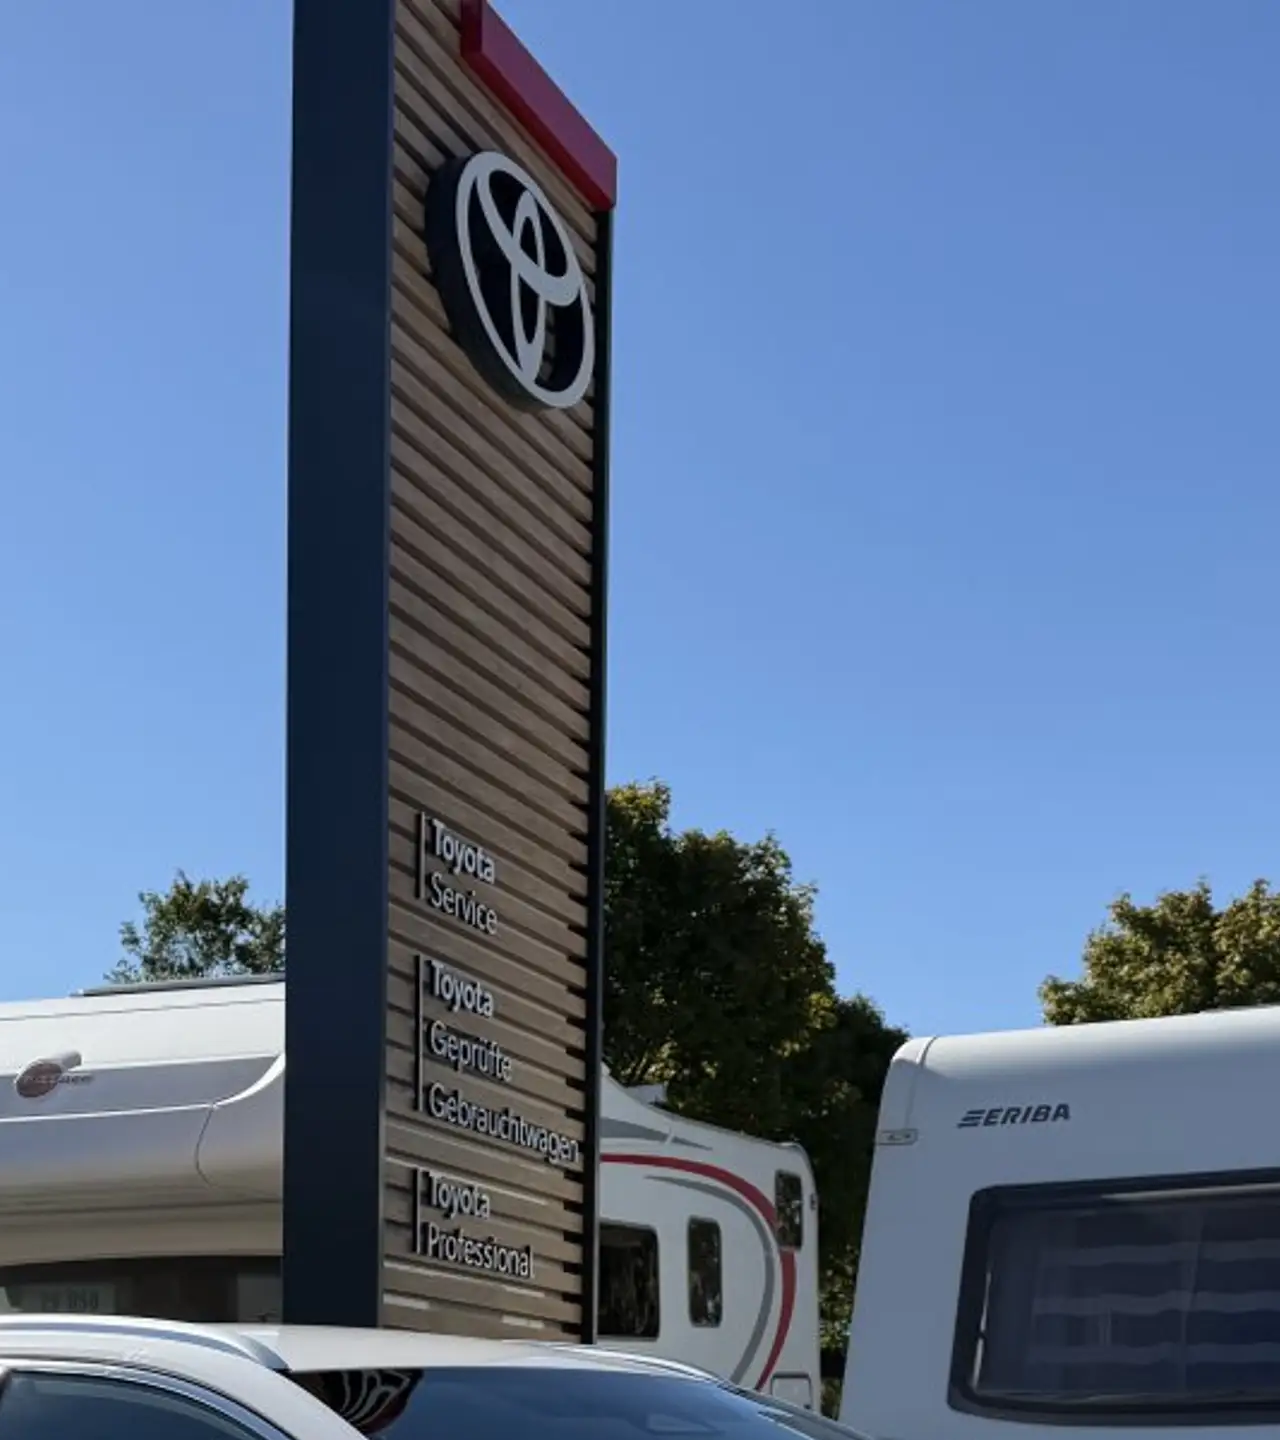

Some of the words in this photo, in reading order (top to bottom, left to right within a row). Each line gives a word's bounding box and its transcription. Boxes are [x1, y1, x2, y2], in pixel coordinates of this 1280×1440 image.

[432, 818, 495, 885] Toyota
[431, 871, 498, 935] Service
[430, 958, 494, 1017] Toyota
[430, 1020, 513, 1082] Geprüfte
[429, 1081, 580, 1164] Gebrauchtwagen
[982, 1103, 1071, 1126] ERIBA
[429, 1171, 490, 1219] Toyota
[428, 1221, 535, 1279] Professional
